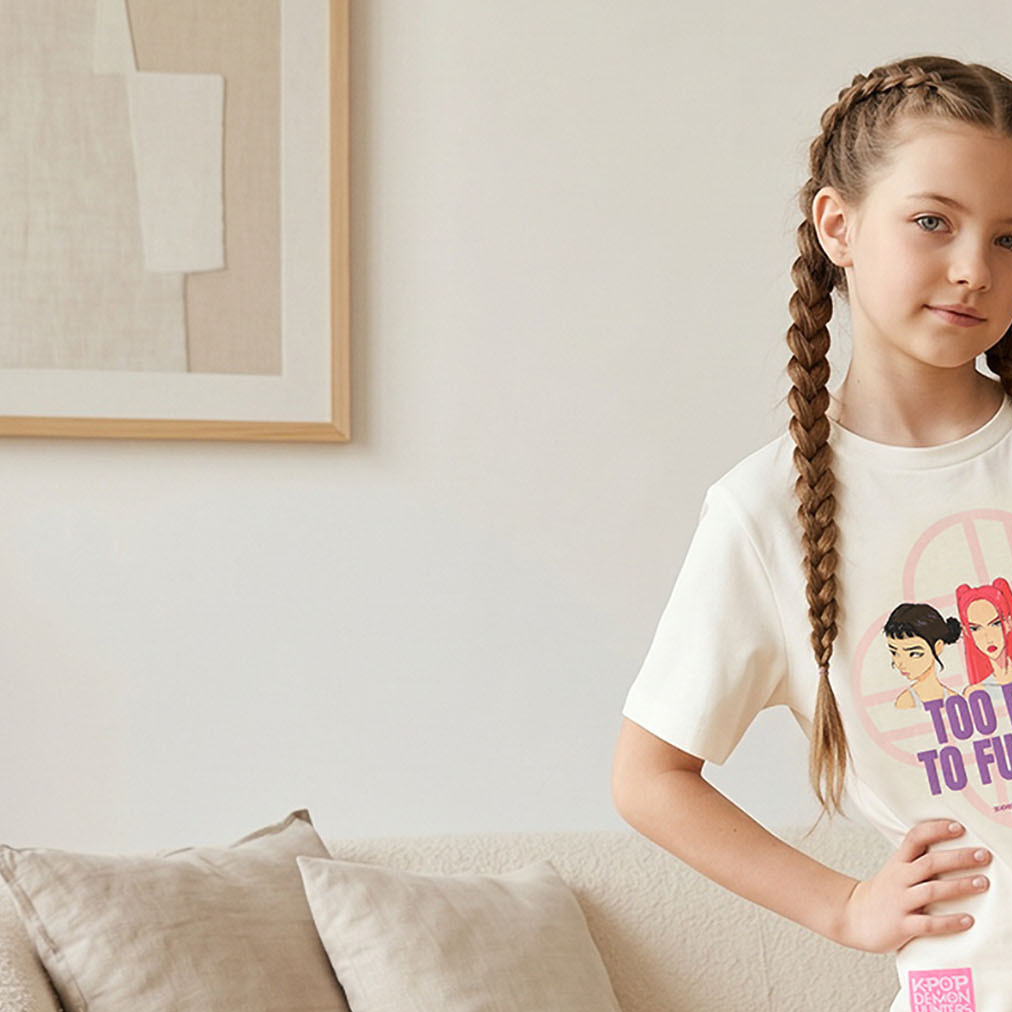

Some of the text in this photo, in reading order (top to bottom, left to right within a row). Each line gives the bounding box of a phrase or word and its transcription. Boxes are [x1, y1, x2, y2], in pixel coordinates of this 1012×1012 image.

[923, 689, 998, 744] TOO
[917, 746, 968, 795] TO
[911, 975, 969, 993] KPOP
[914, 988, 971, 1005] DEMON
